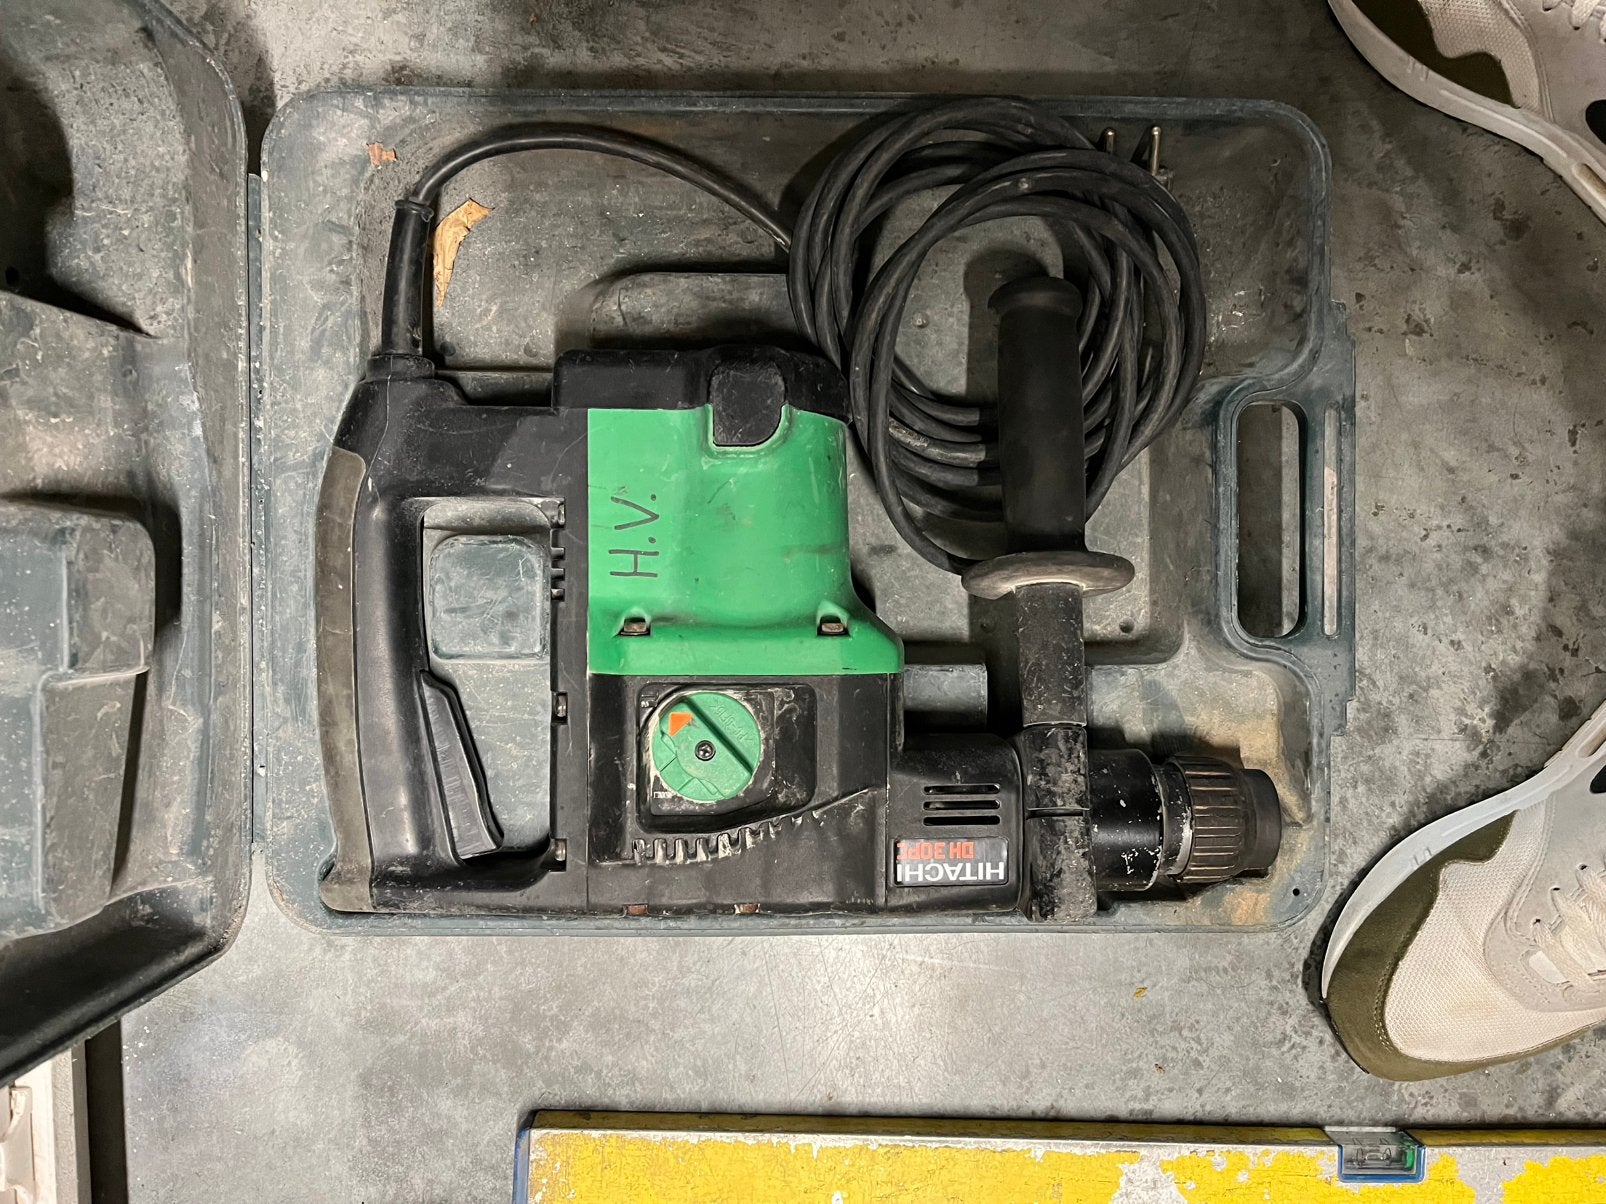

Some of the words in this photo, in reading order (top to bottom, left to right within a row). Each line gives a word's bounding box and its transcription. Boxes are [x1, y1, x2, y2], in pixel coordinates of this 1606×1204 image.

[608, 493, 660, 578] H.V.
[896, 841, 946, 860] 30PC
[949, 841, 975, 859] DH
[896, 861, 1005, 882] HITACHI
